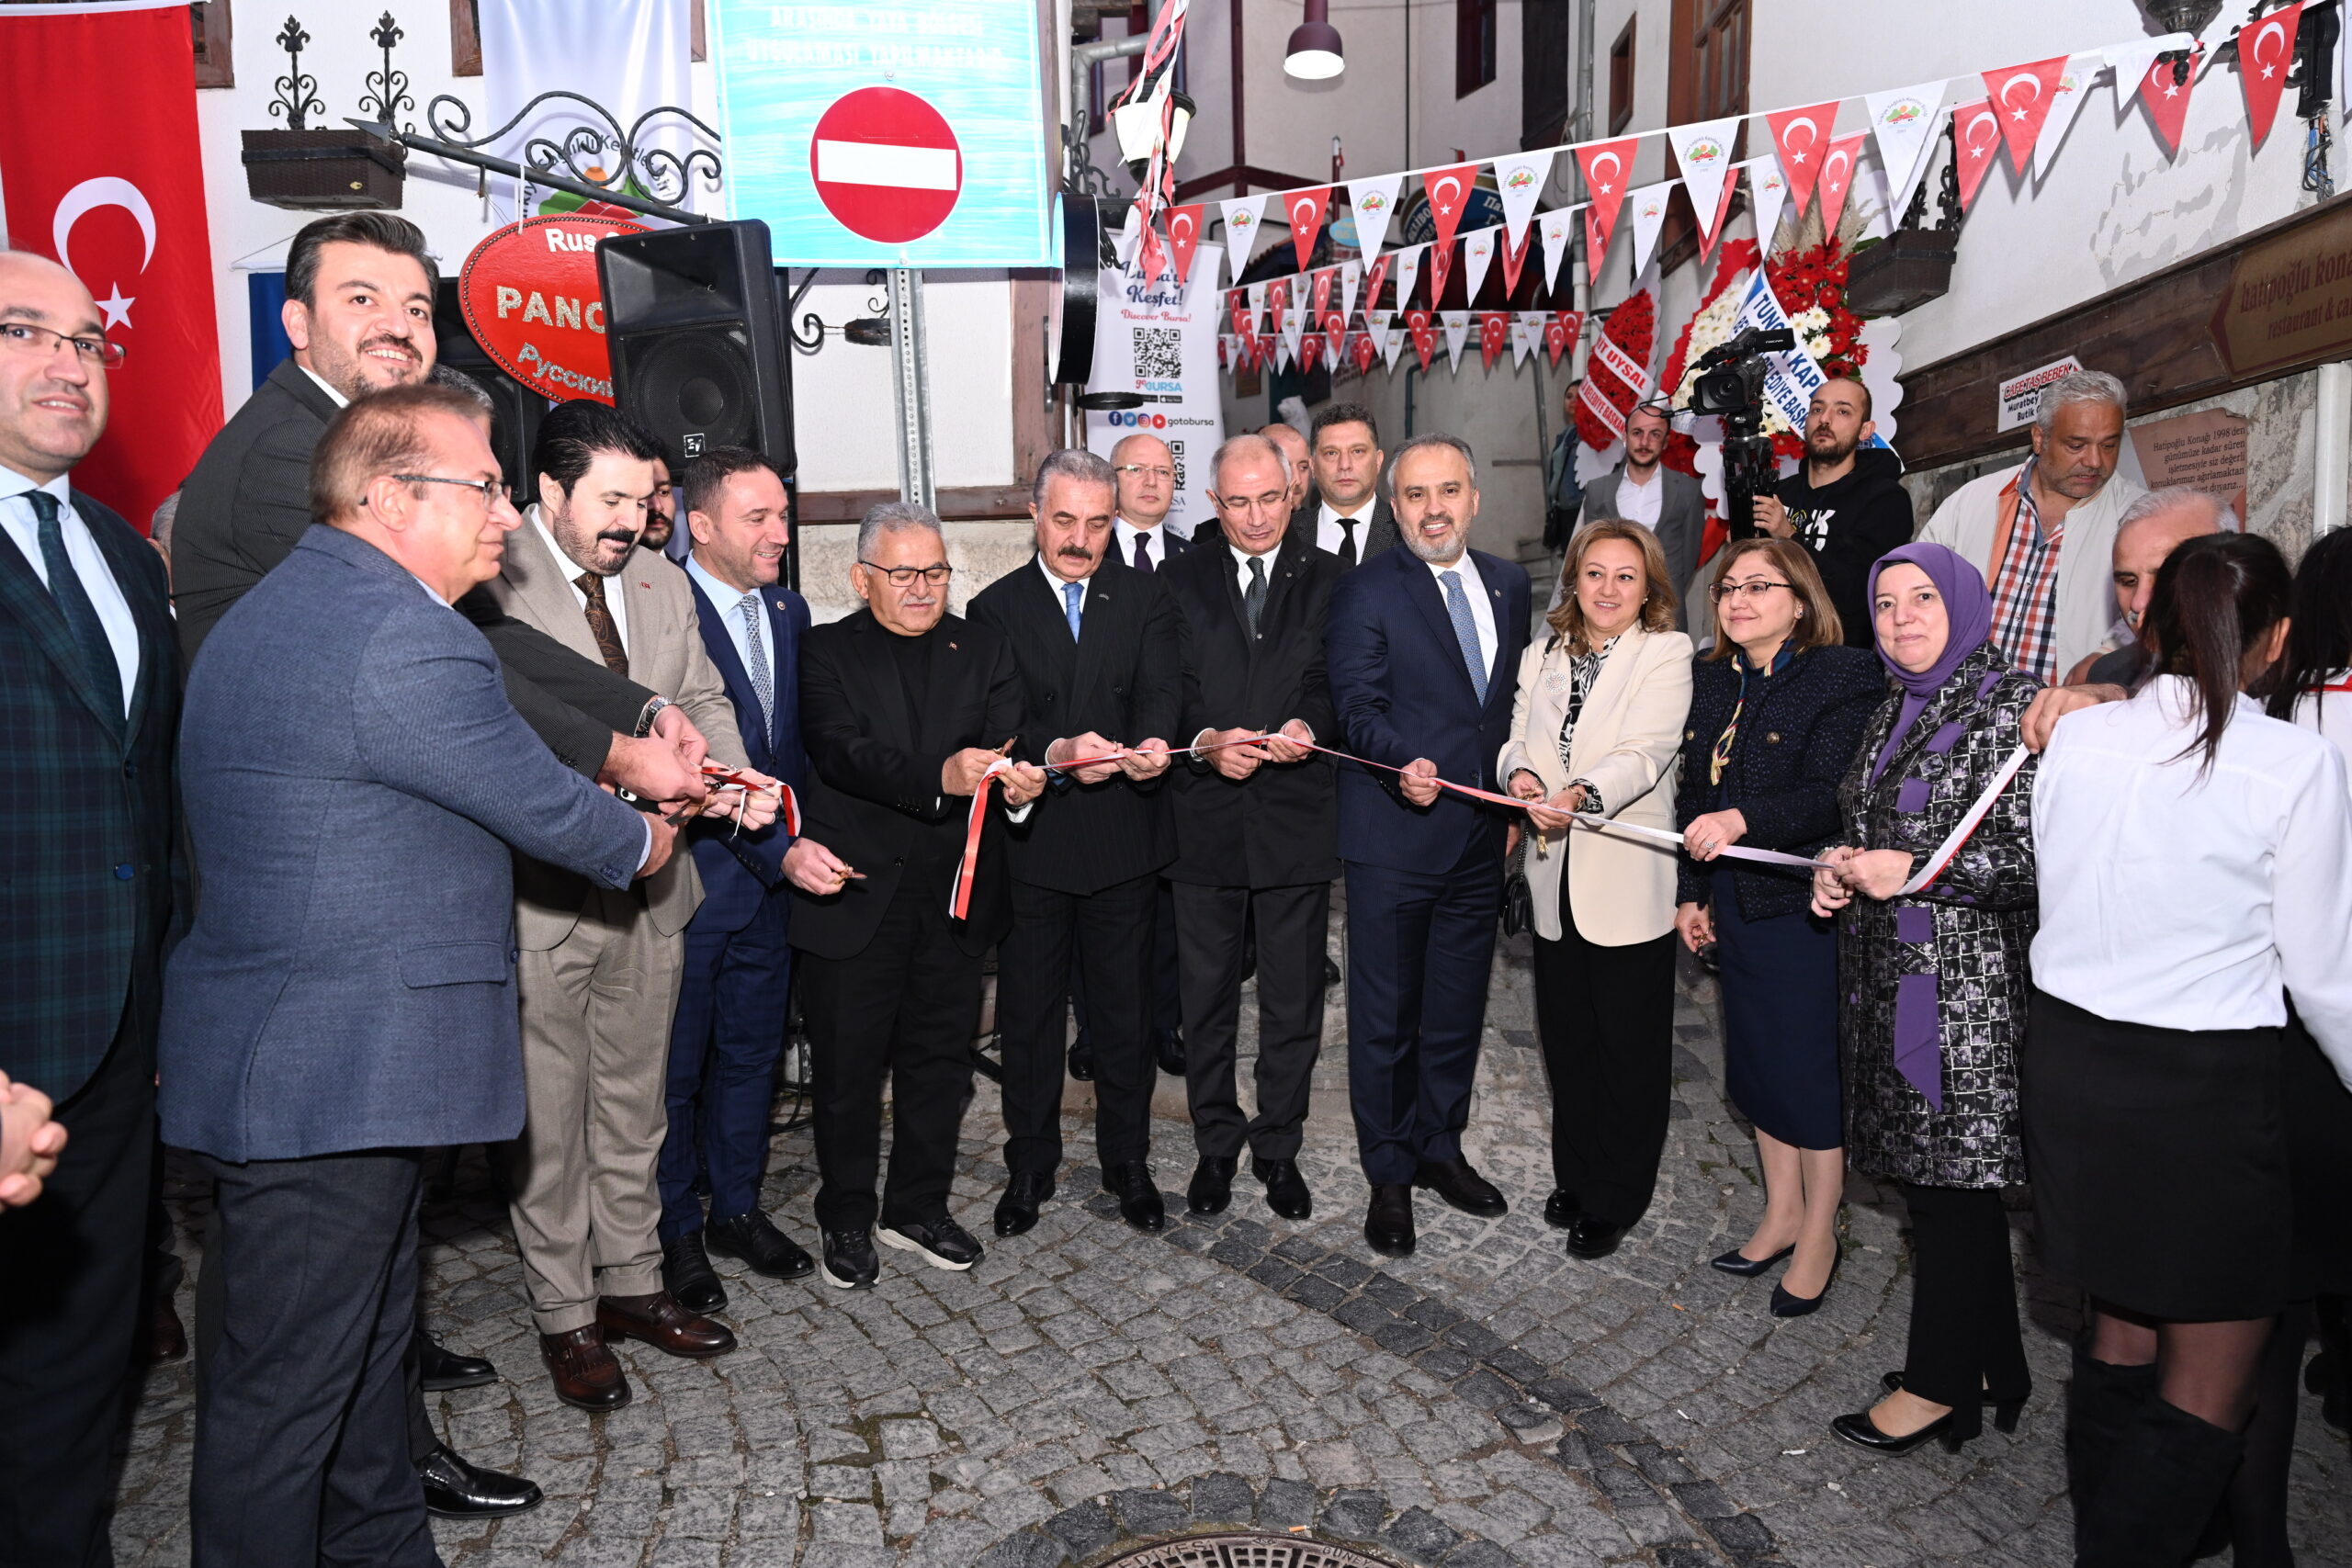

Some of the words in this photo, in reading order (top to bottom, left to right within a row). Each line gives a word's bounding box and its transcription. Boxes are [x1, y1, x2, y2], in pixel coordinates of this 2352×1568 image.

[866, 8, 908, 31] YAYA
[1126, 284, 1183, 308] Keşfet!
[1121, 309, 1159, 321] Discover
[1161, 311, 1192, 322] Bursa!
[2267, 304, 2324, 340] restaurant
[2325, 297, 2334, 322] &
[1606, 350, 1646, 389] UYSAL
[2004, 379, 2025, 400] CAFE
[2024, 374, 2041, 392] TAŞ
[2040, 362, 2071, 385] BEBEK
[2007, 395, 2039, 412] Muratbey
[2017, 409, 2034, 421] Butik
[1168, 417, 1214, 427] gotobursa
[2154, 438, 2185, 452] Hatipoğlu
[2188, 434, 2211, 445] Konağı
[2213, 426, 2245, 440] 1998'den
[2164, 448, 2199, 464] günümüze
[2201, 445, 2222, 456] kadar
[2223, 439, 2245, 451] süren
[2209, 457, 2219, 468] siz
[2220, 452, 2245, 466] değerli
[2197, 467, 2245, 483] ağırlamaktan
